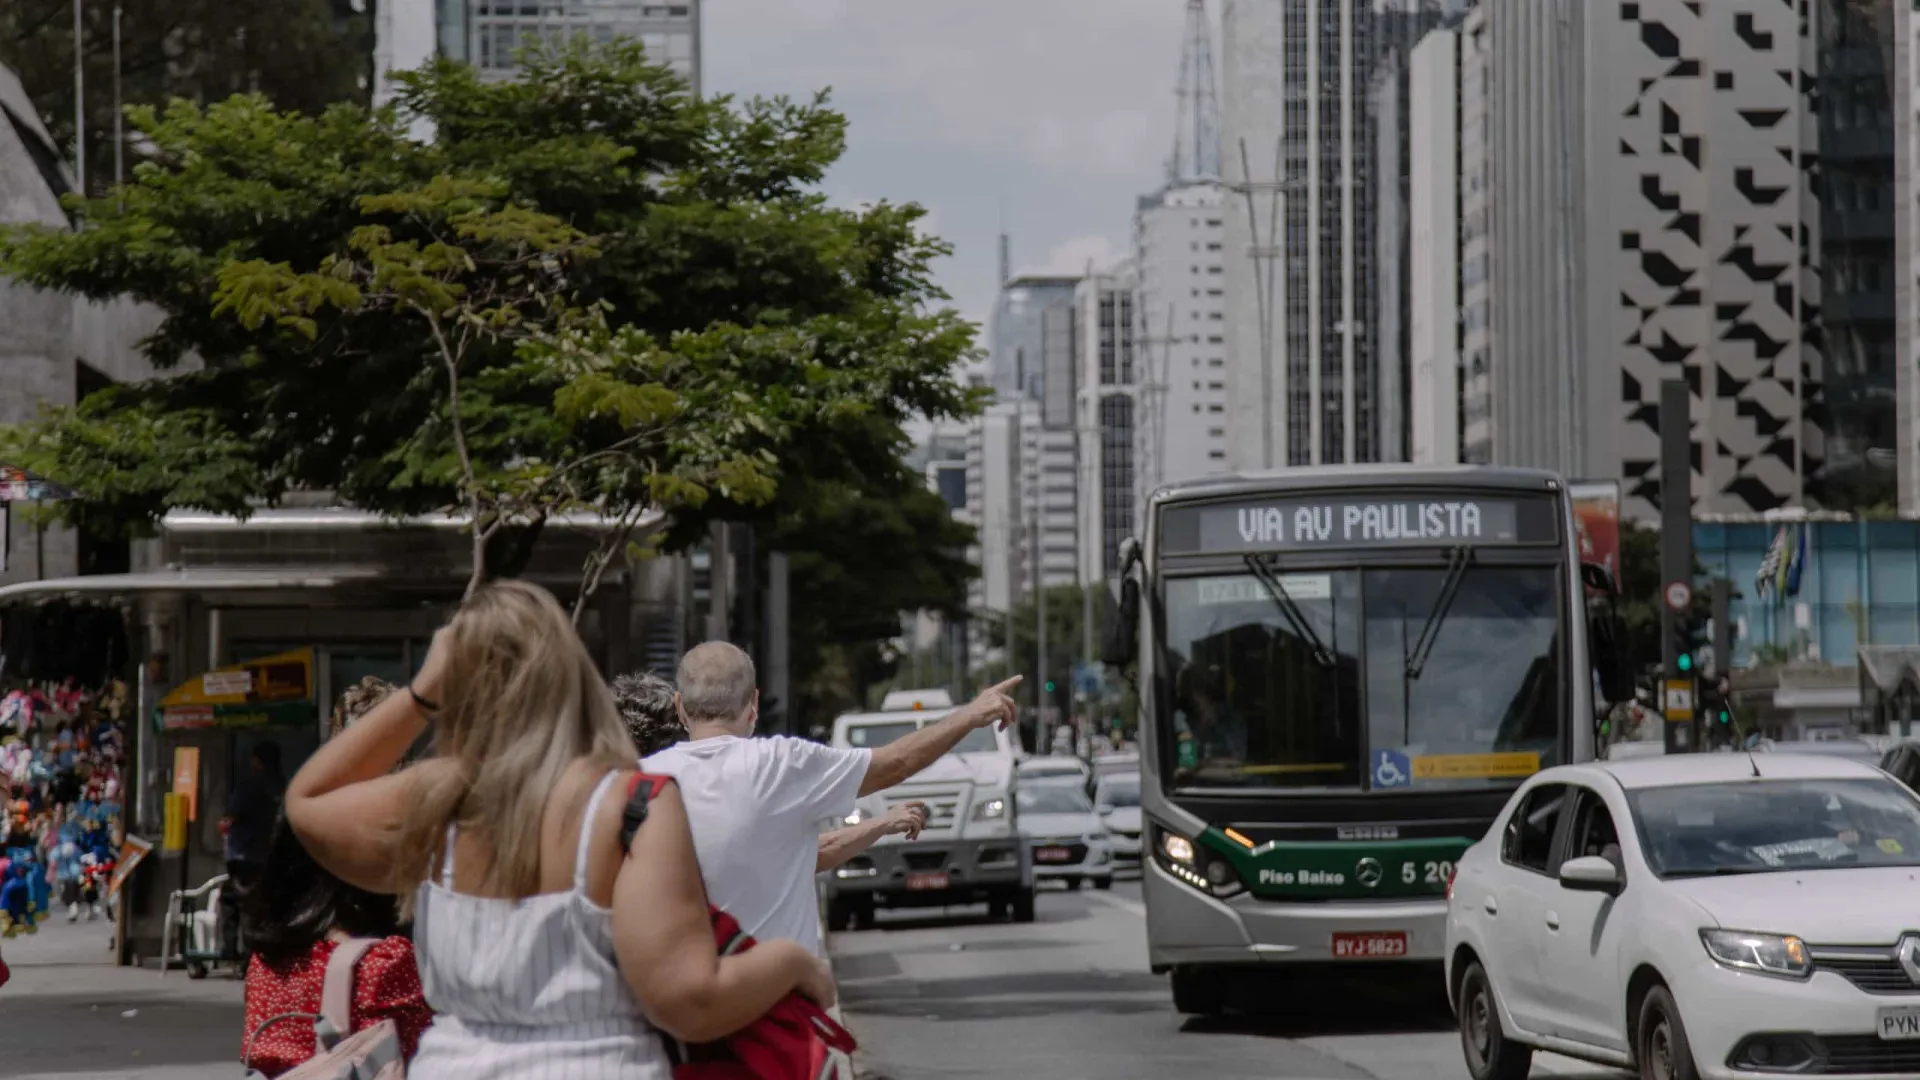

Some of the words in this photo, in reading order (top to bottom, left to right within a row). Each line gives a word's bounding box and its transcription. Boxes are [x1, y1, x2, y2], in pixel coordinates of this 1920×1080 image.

[1238, 507, 1284, 543] VIA
[1294, 506, 1333, 541] AV
[1343, 502, 1482, 540] PAULISTA
[1259, 869, 1294, 885] Piso
[1298, 869, 1345, 885] Baixo
[1402, 861, 1417, 885] 5
[1424, 860, 1457, 884] 20
[1883, 1015, 1920, 1035] PYN
